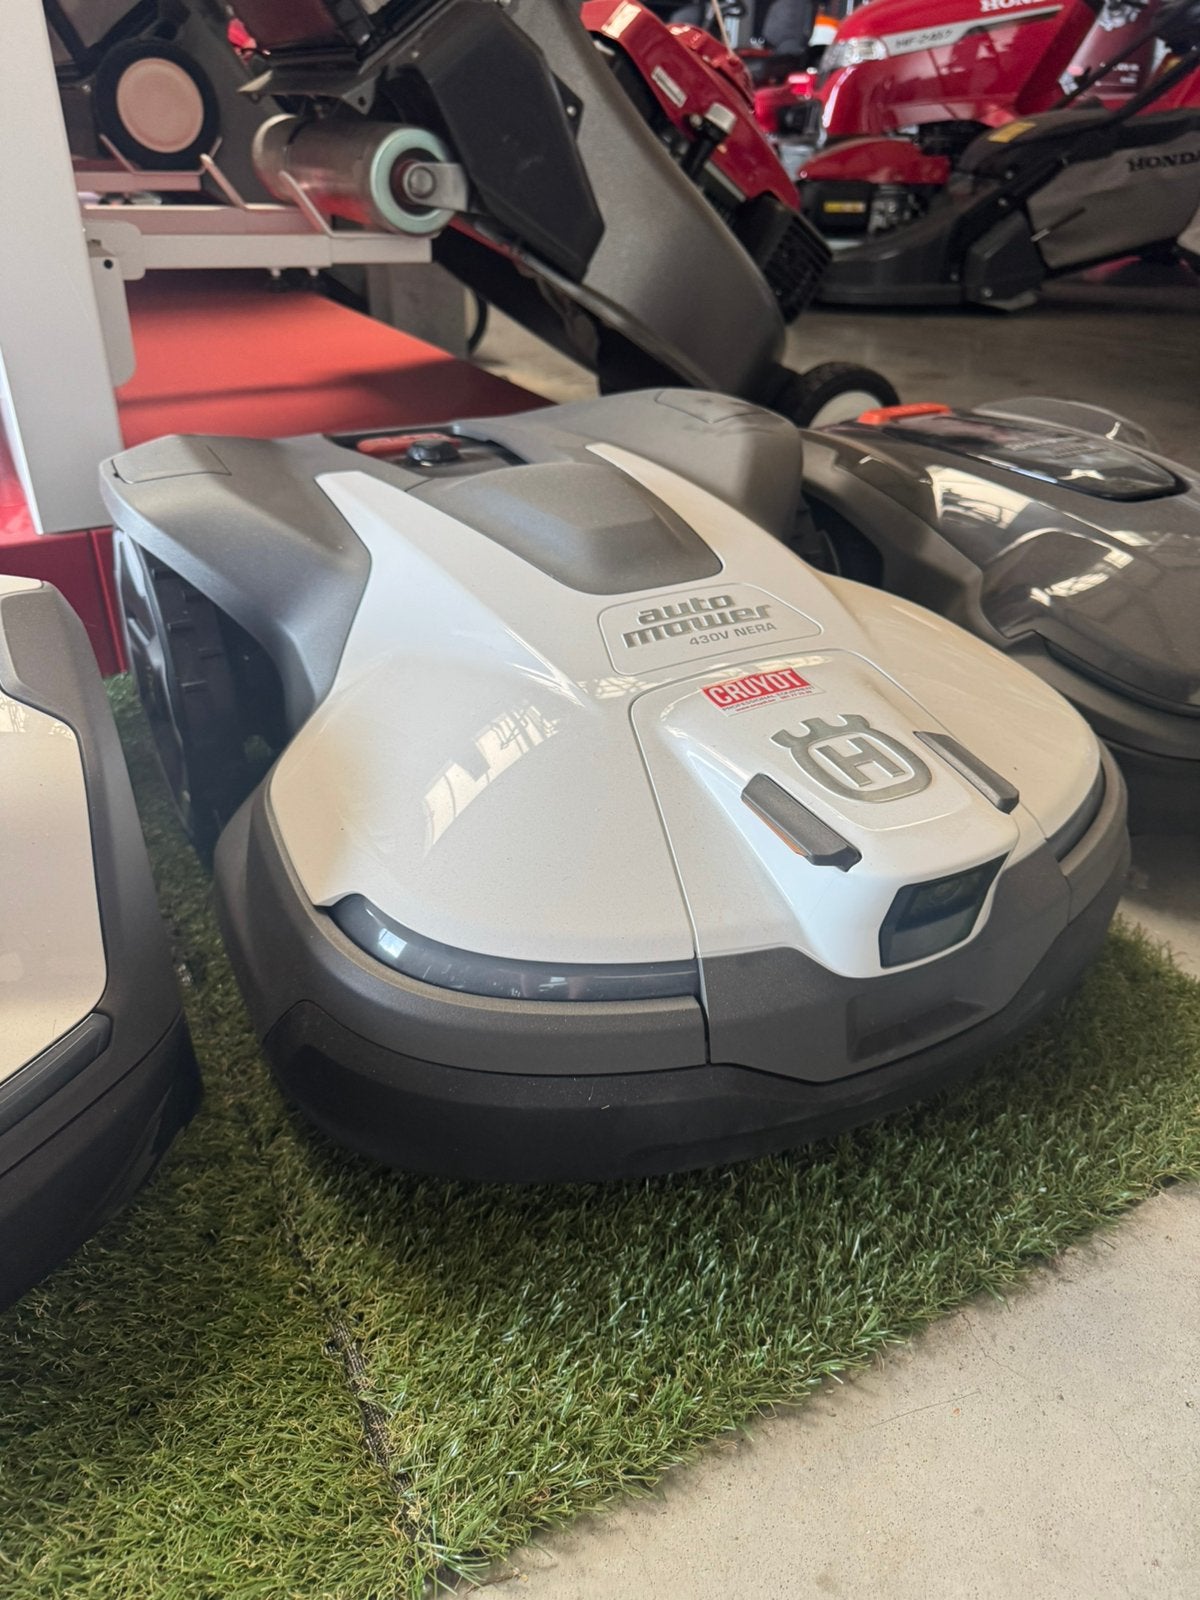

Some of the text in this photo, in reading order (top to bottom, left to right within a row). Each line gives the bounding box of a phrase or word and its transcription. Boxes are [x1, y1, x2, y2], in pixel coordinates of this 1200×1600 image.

[622, 604, 772, 648] mower
[638, 595, 735, 625] auto
[689, 623, 777, 646] 430V NERA
[708, 670, 802, 705] CRUYDT
